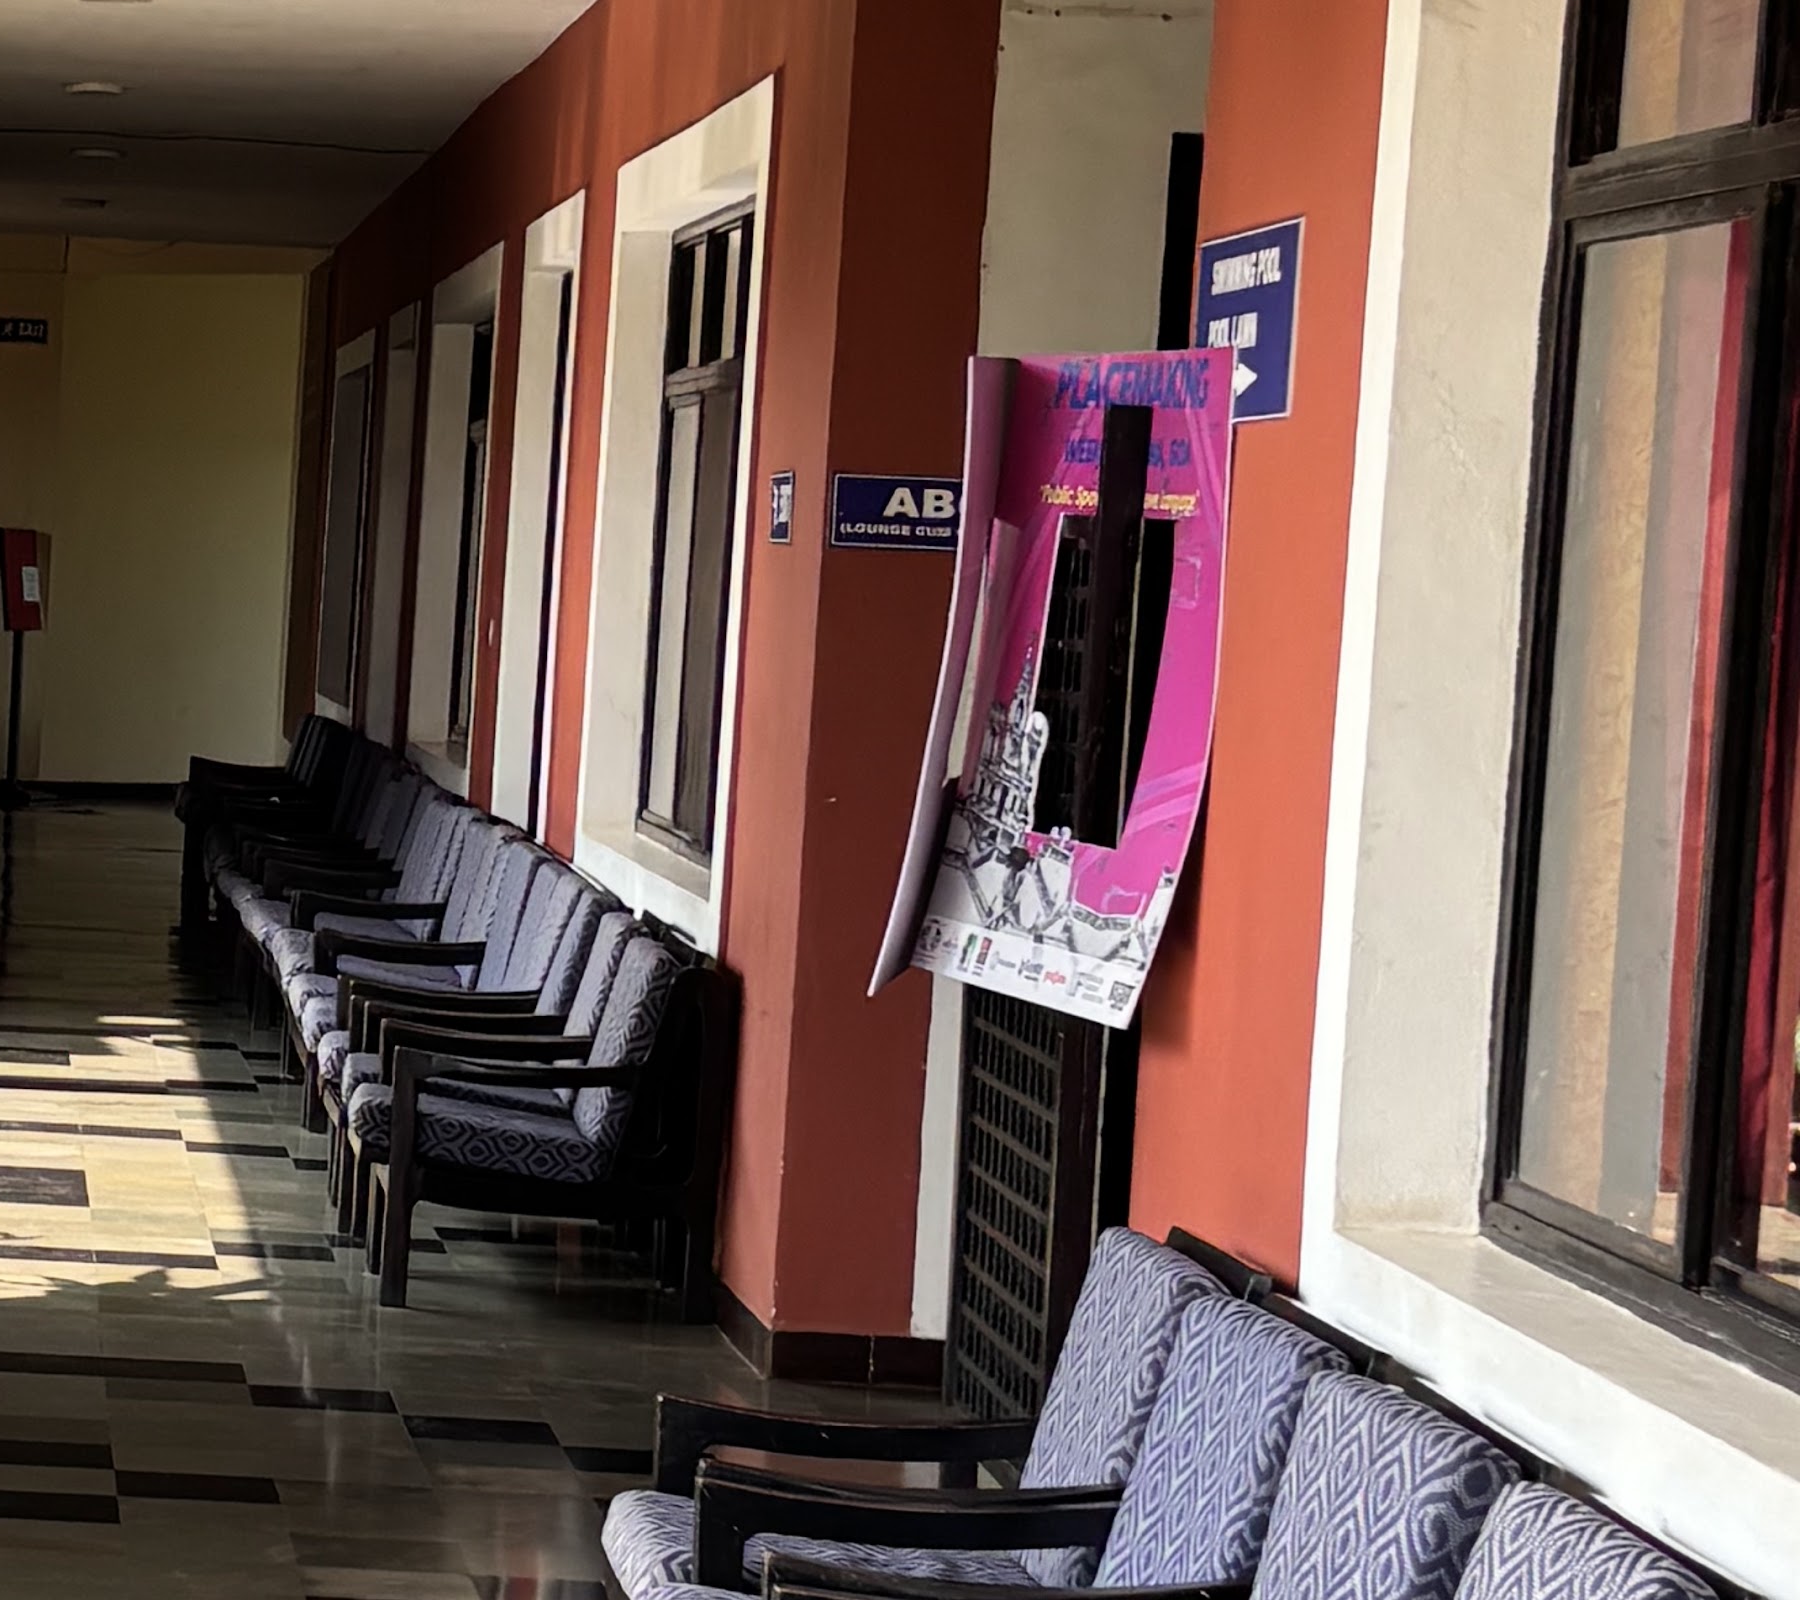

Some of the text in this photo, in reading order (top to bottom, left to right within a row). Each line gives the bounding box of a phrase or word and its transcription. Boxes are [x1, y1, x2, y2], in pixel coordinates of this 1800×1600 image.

[1257, 246, 1282, 286] POOL
[1208, 317, 1230, 349] POOL
[1054, 359, 1208, 410] PLACEMAKING
